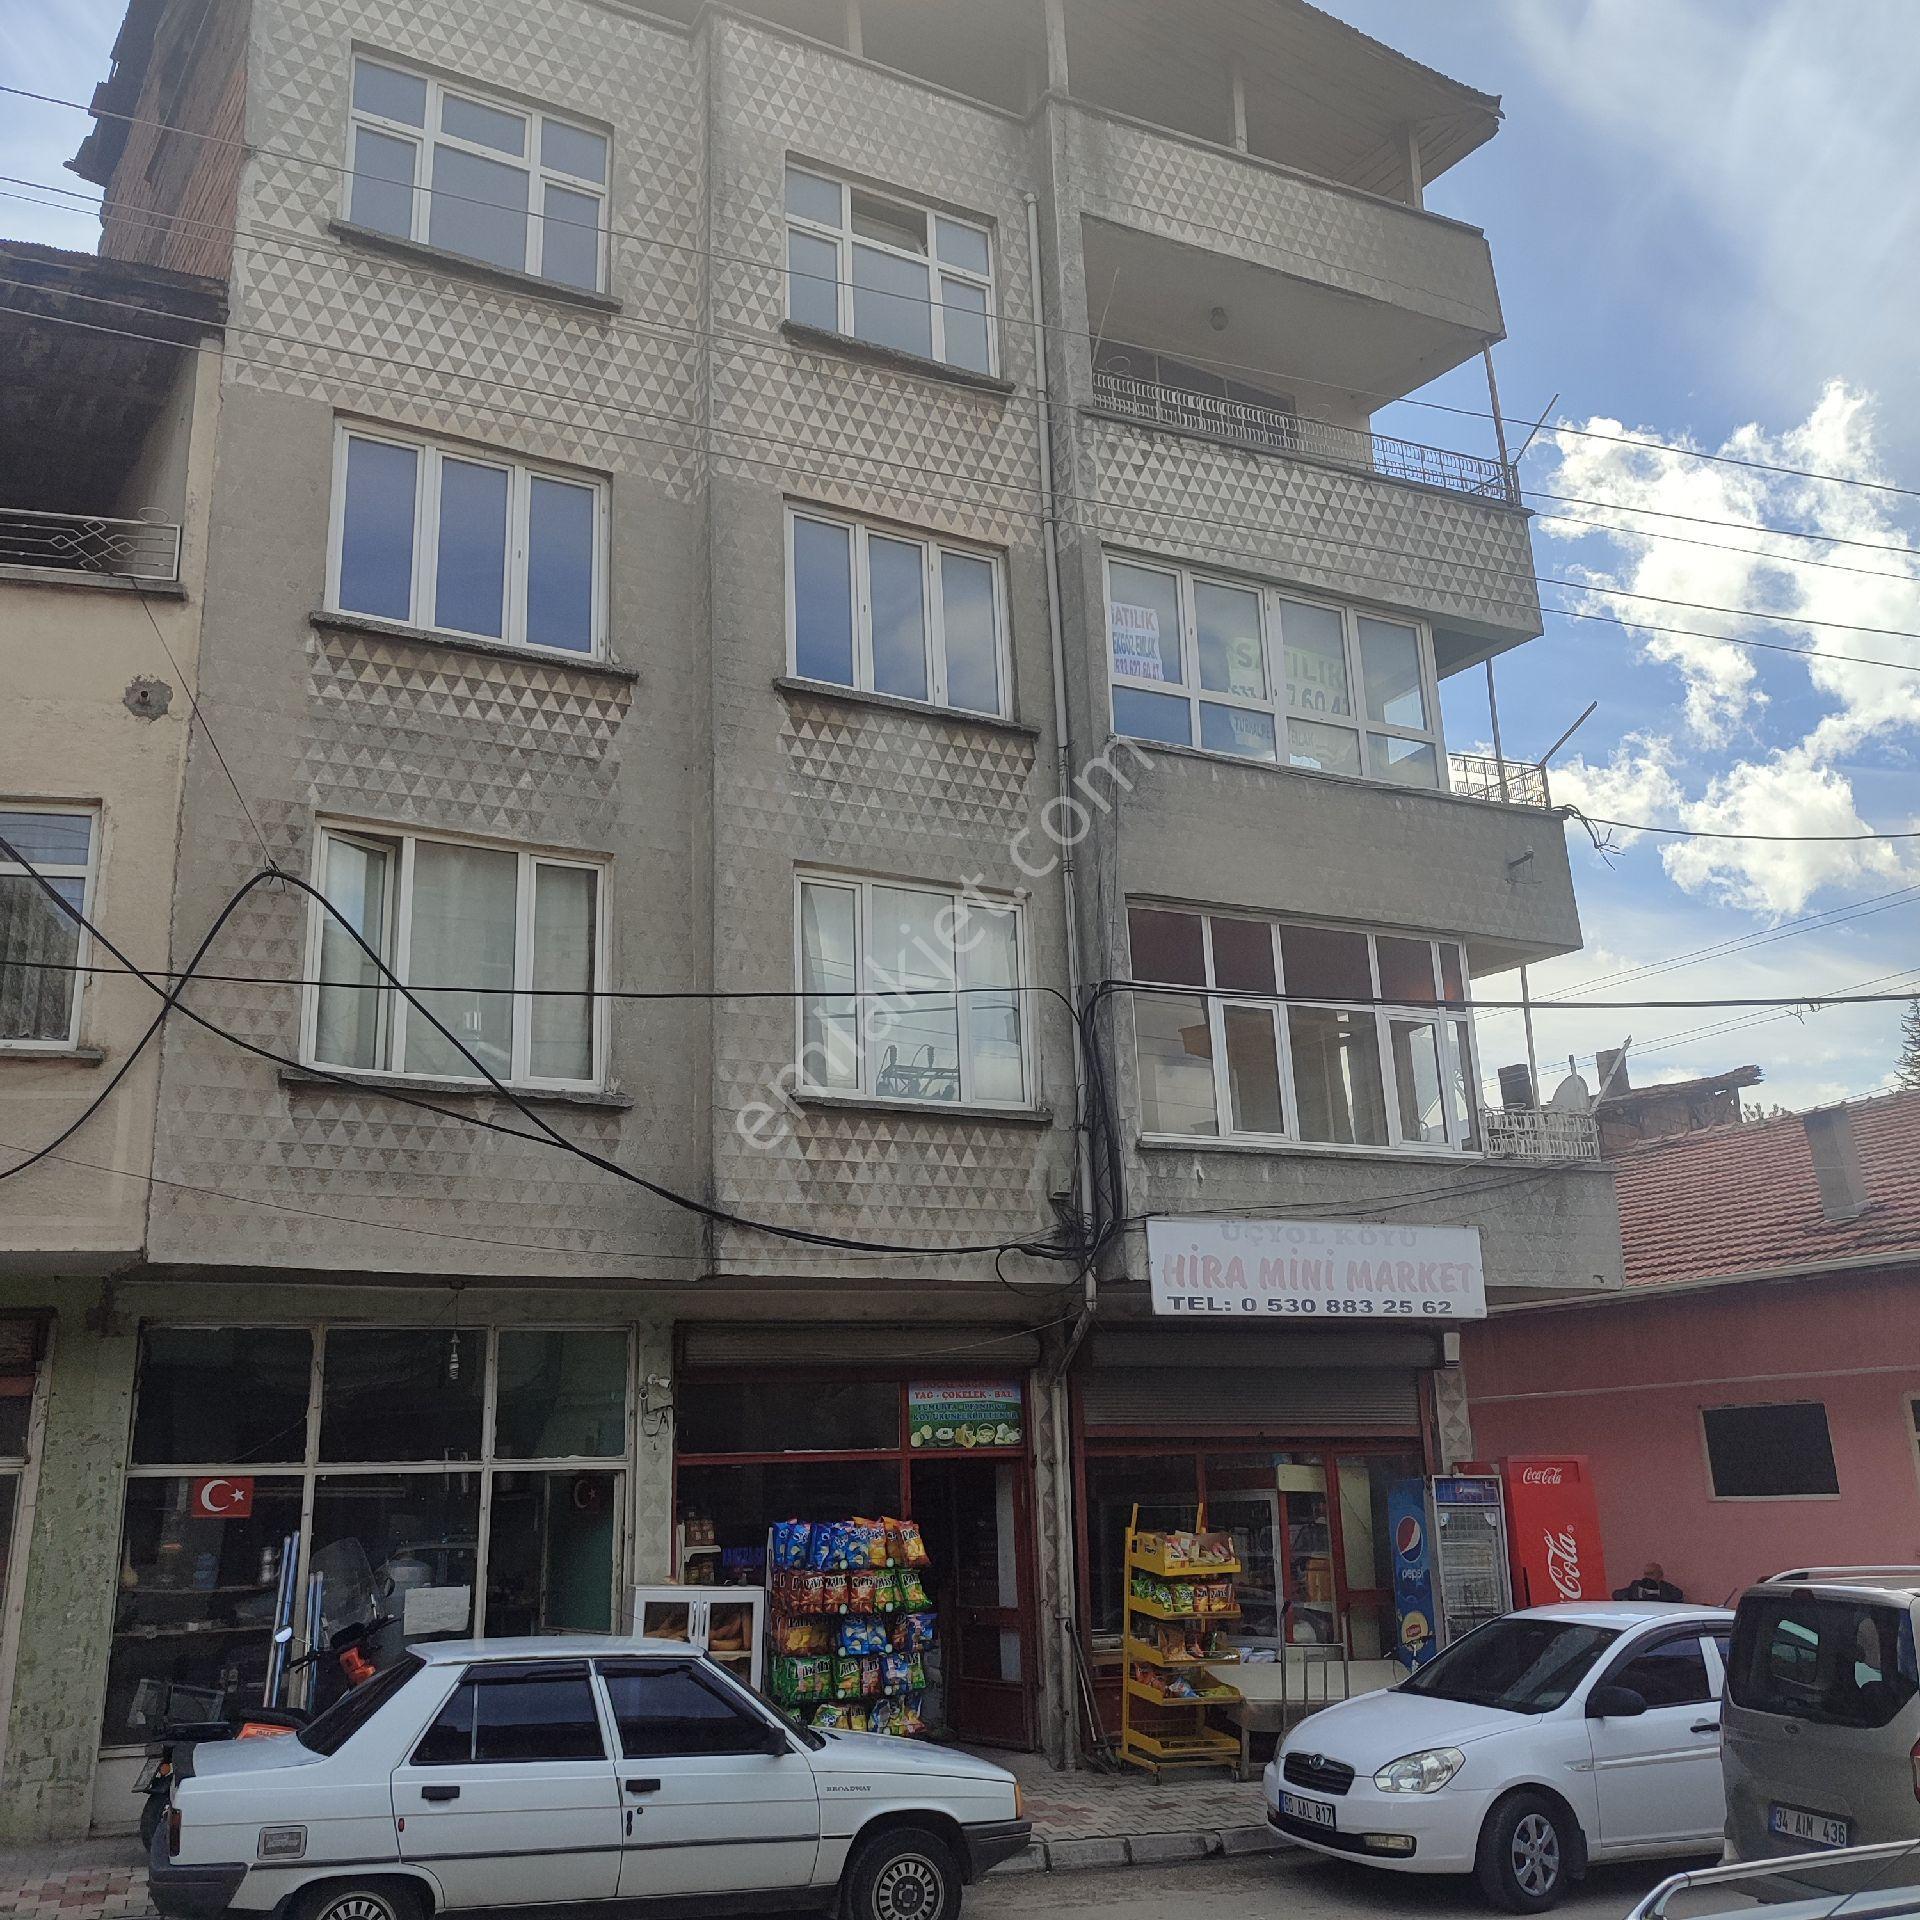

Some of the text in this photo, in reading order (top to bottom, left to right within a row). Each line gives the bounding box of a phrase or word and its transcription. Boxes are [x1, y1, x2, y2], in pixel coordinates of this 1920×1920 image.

[1236, 642, 1345, 689] SILIK
[1220, 1220, 1418, 1248] ÜÇYOL KÖYÜ
[1163, 1244, 1474, 1294] HİRA MİNİ MARKET
[1167, 1295, 1453, 1315] TEL: 0 530 883 25 62
[994, 1390, 1013, 1398] BAL
[1402, 1566, 1424, 1582] pepsi
[1297, 1800, 1312, 1818] AAL
[1315, 1804, 1332, 1823] 817
[1776, 1809, 1845, 1844] 34 AIM 436
